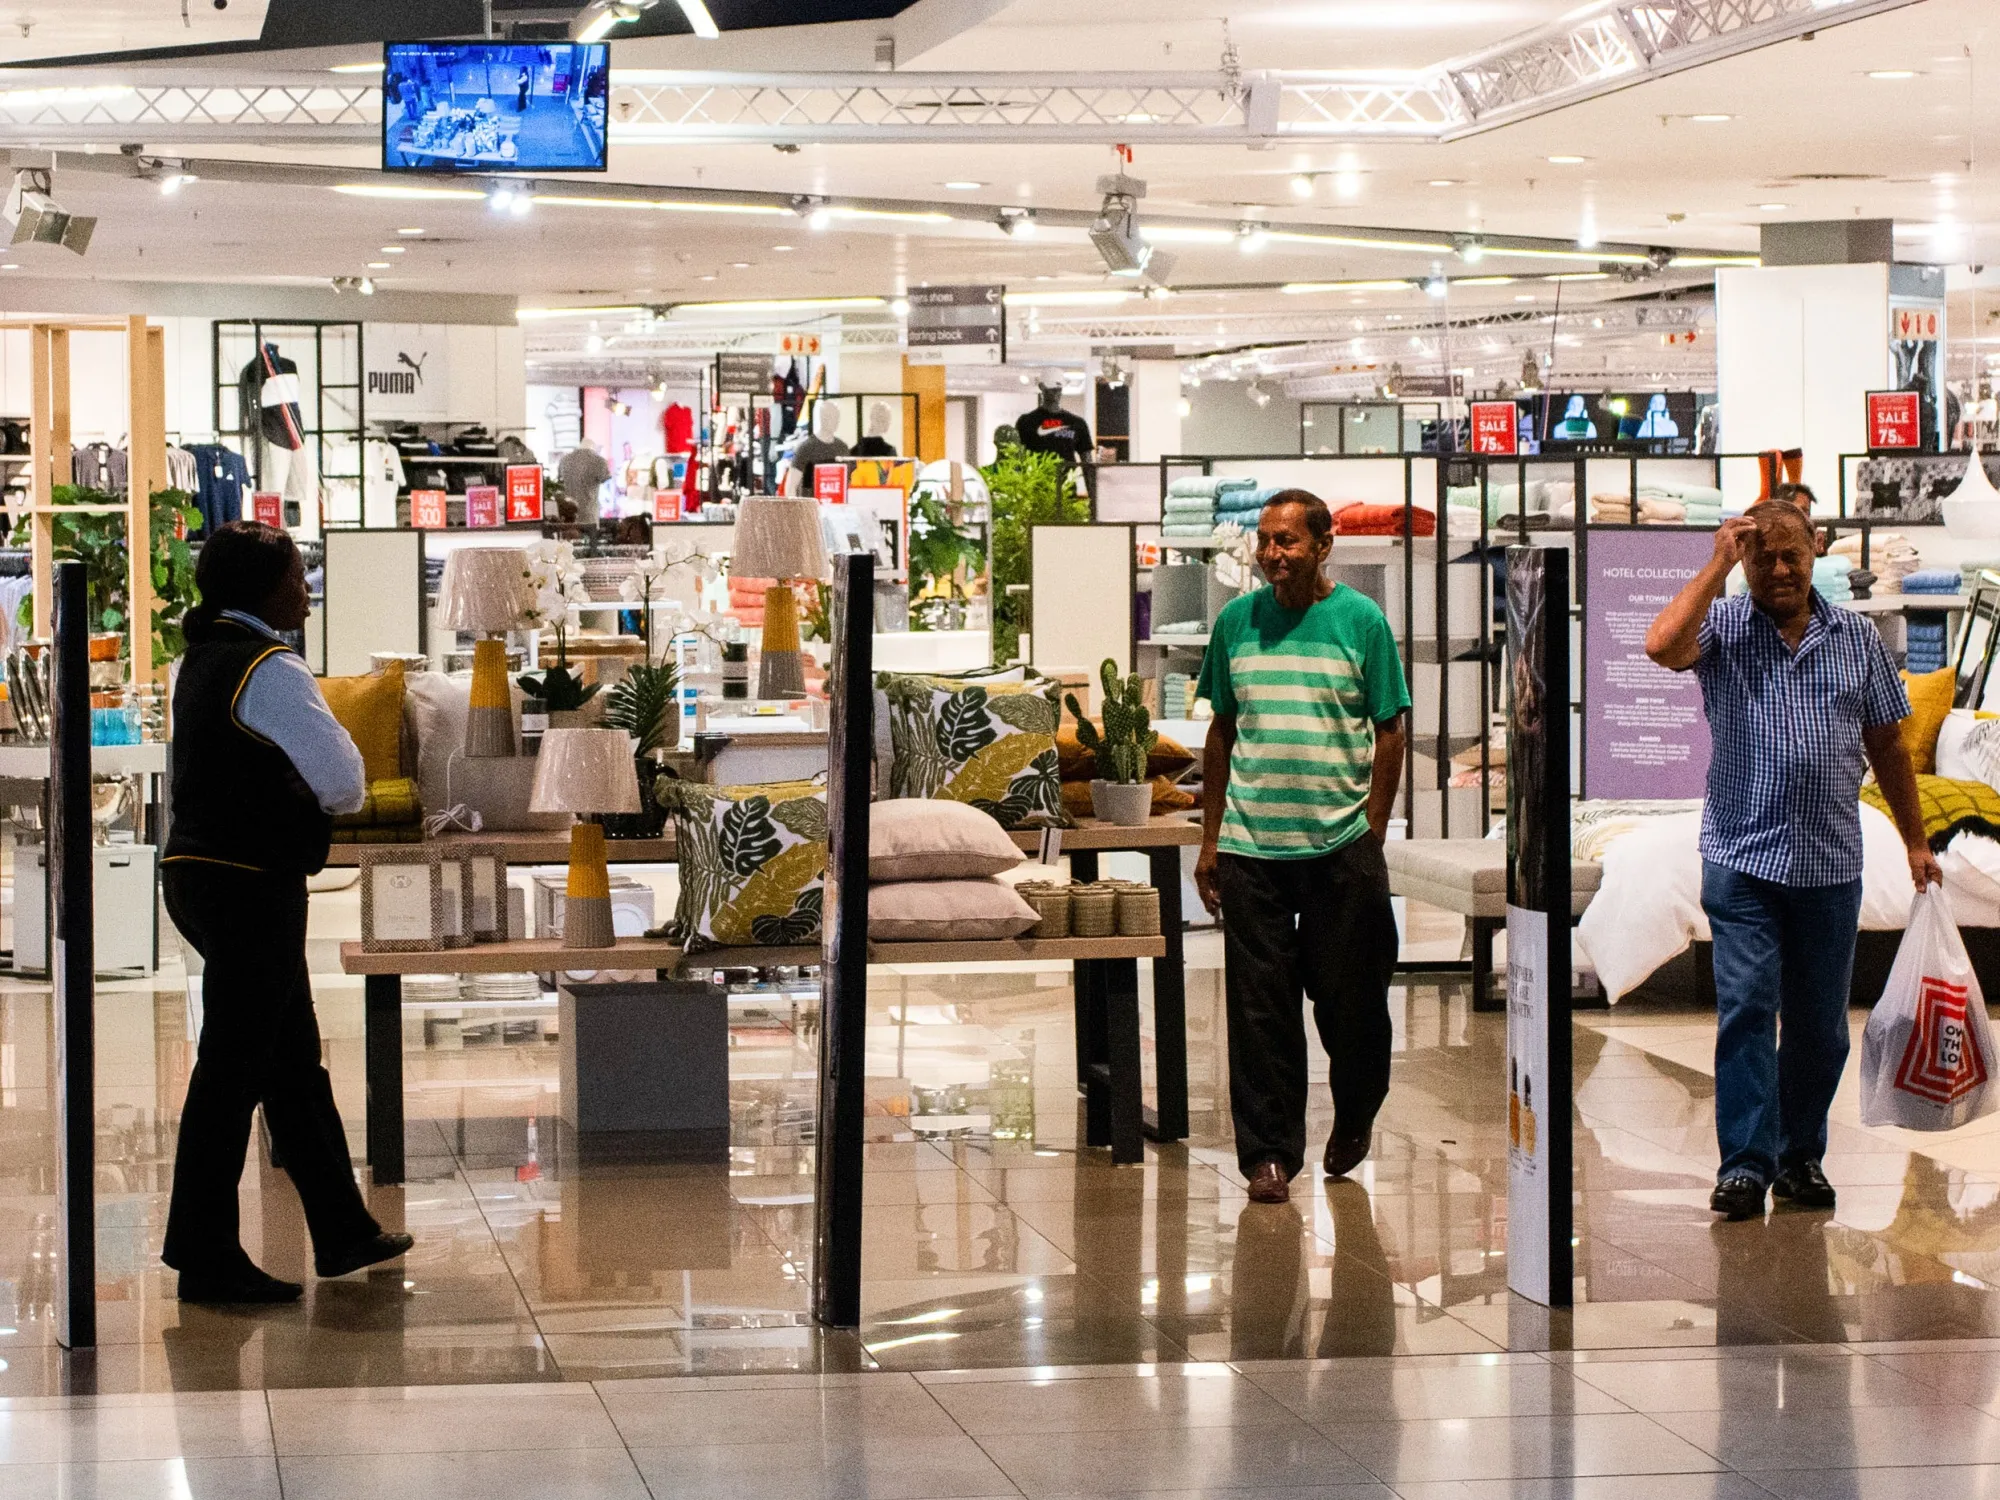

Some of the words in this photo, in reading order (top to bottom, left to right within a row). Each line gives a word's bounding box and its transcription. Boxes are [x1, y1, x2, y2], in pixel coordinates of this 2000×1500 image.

[368, 371, 415, 394] PUMA
[1877, 411, 1909, 424] SALE
[1479, 419, 1508, 432] SALE
[513, 484, 535, 497] SALE
[820, 481, 840, 493] SALE
[419, 494, 439, 506] SALE
[473, 501, 491, 510] SALE
[258, 507, 276, 517] SALE
[1603, 568, 1635, 578] HOTEL
